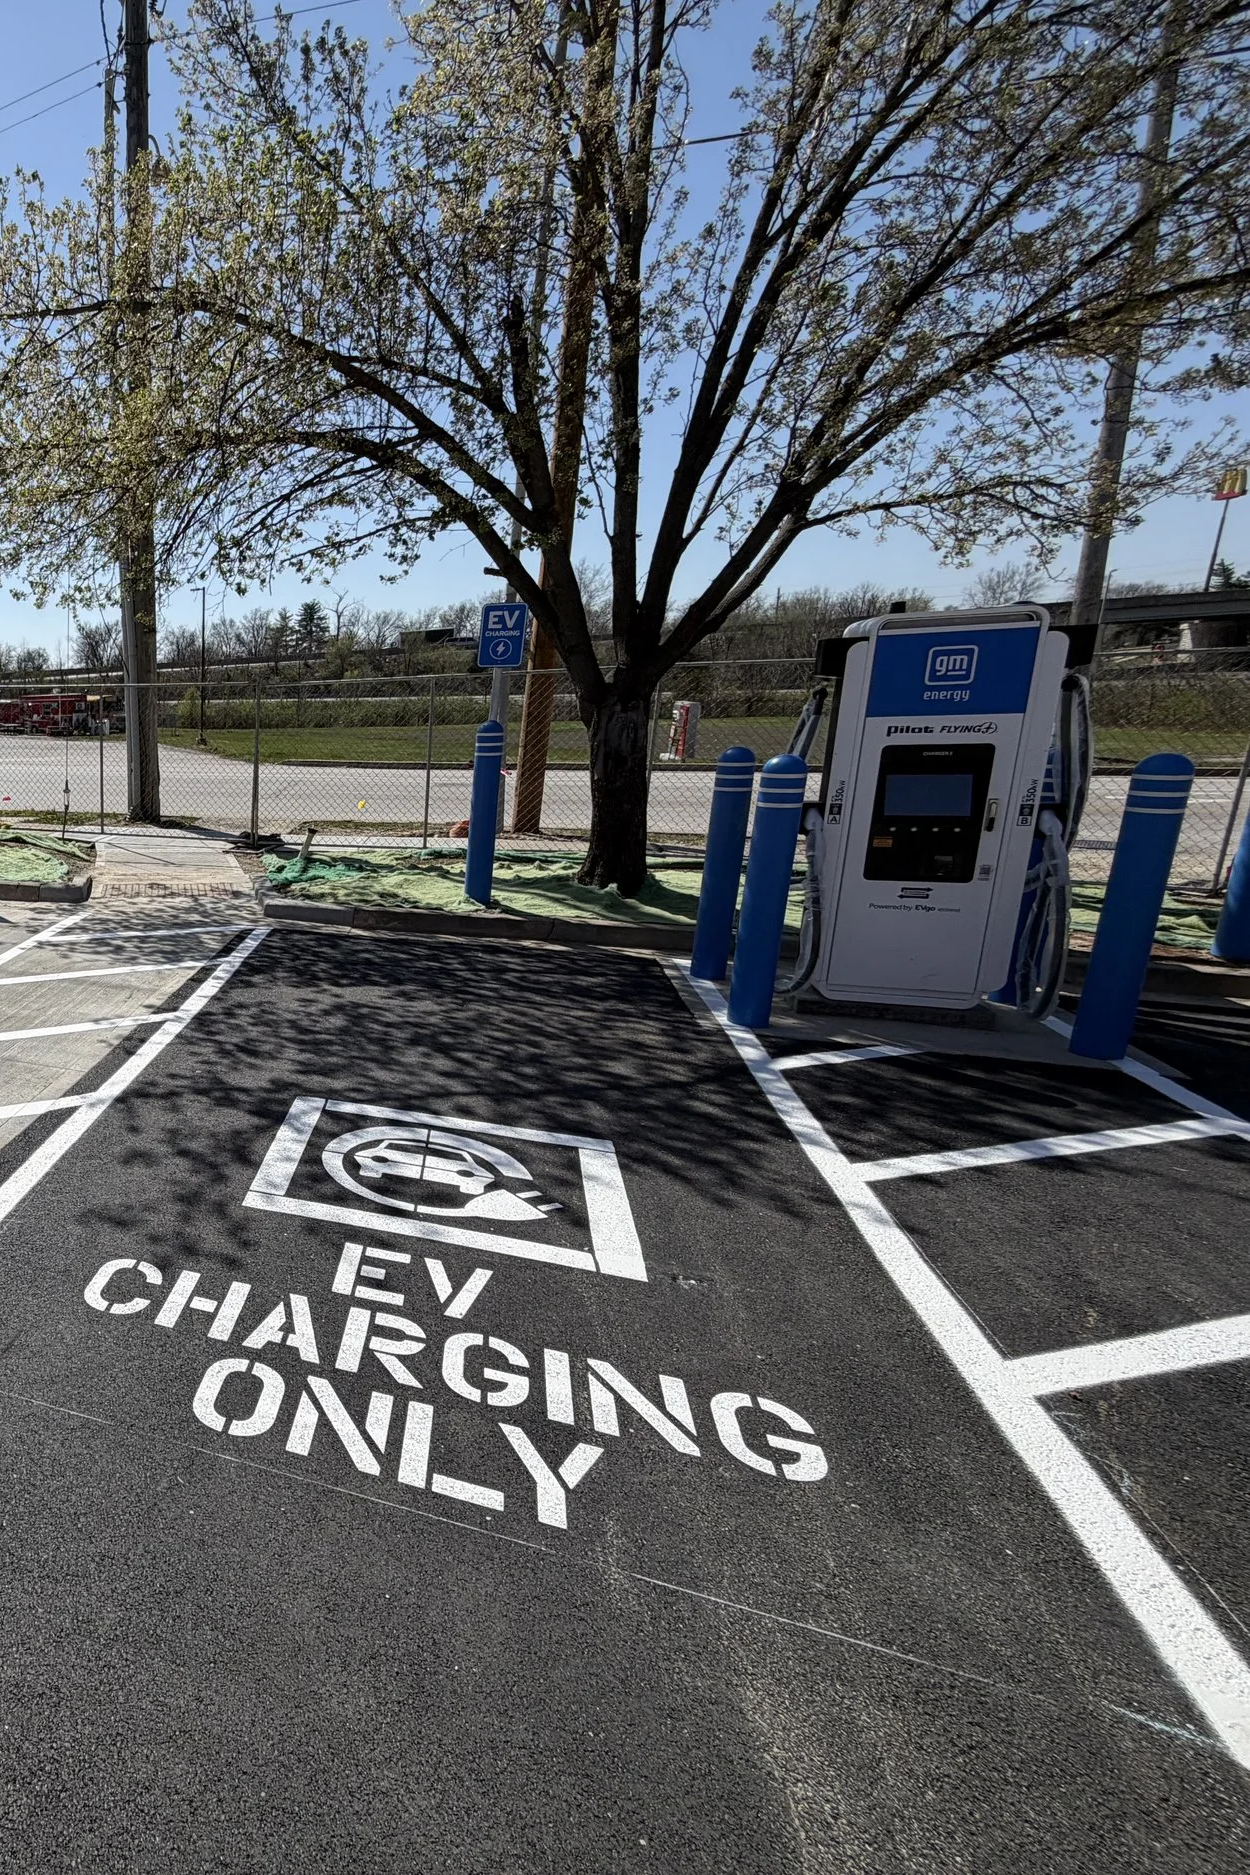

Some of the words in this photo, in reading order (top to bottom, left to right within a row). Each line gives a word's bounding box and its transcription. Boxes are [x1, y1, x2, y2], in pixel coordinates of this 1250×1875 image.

[488, 610, 520, 629] EV
[935, 655, 968, 676] gm
[923, 690, 970, 701] energy
[830, 815, 838, 823] A
[1020, 816, 1029, 825] B
[869, 902, 902, 911] Powered
[914, 904, 936, 912] EVgo
[331, 1242, 493, 1319] EV
[82, 1258, 828, 1483] CHARGING
[192, 1358, 604, 1529] ONLY
